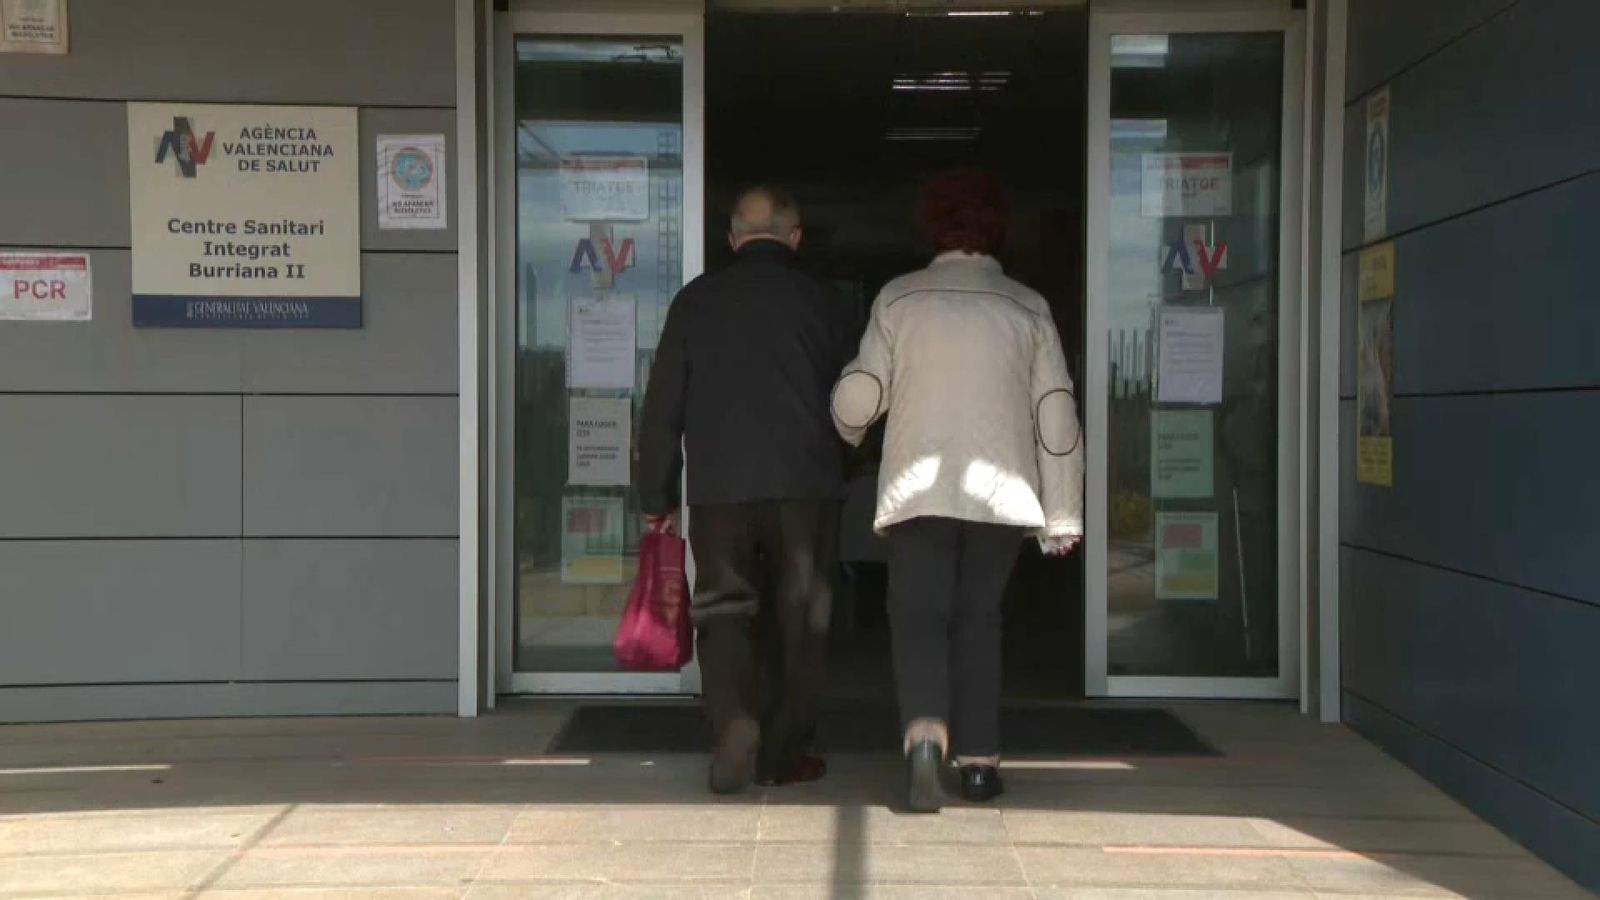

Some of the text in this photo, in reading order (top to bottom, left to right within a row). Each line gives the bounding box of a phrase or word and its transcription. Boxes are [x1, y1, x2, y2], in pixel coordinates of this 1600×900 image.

[239, 123, 317, 140] AGÈNCIA
[223, 142, 334, 157] VALENCIANA
[238, 159, 321, 173] DE SALUT
[167, 217, 324, 235] Centre Sanitari
[203, 241, 291, 260] Integrat
[189, 263, 306, 279] Burriana II
[14, 279, 66, 300] PCR
